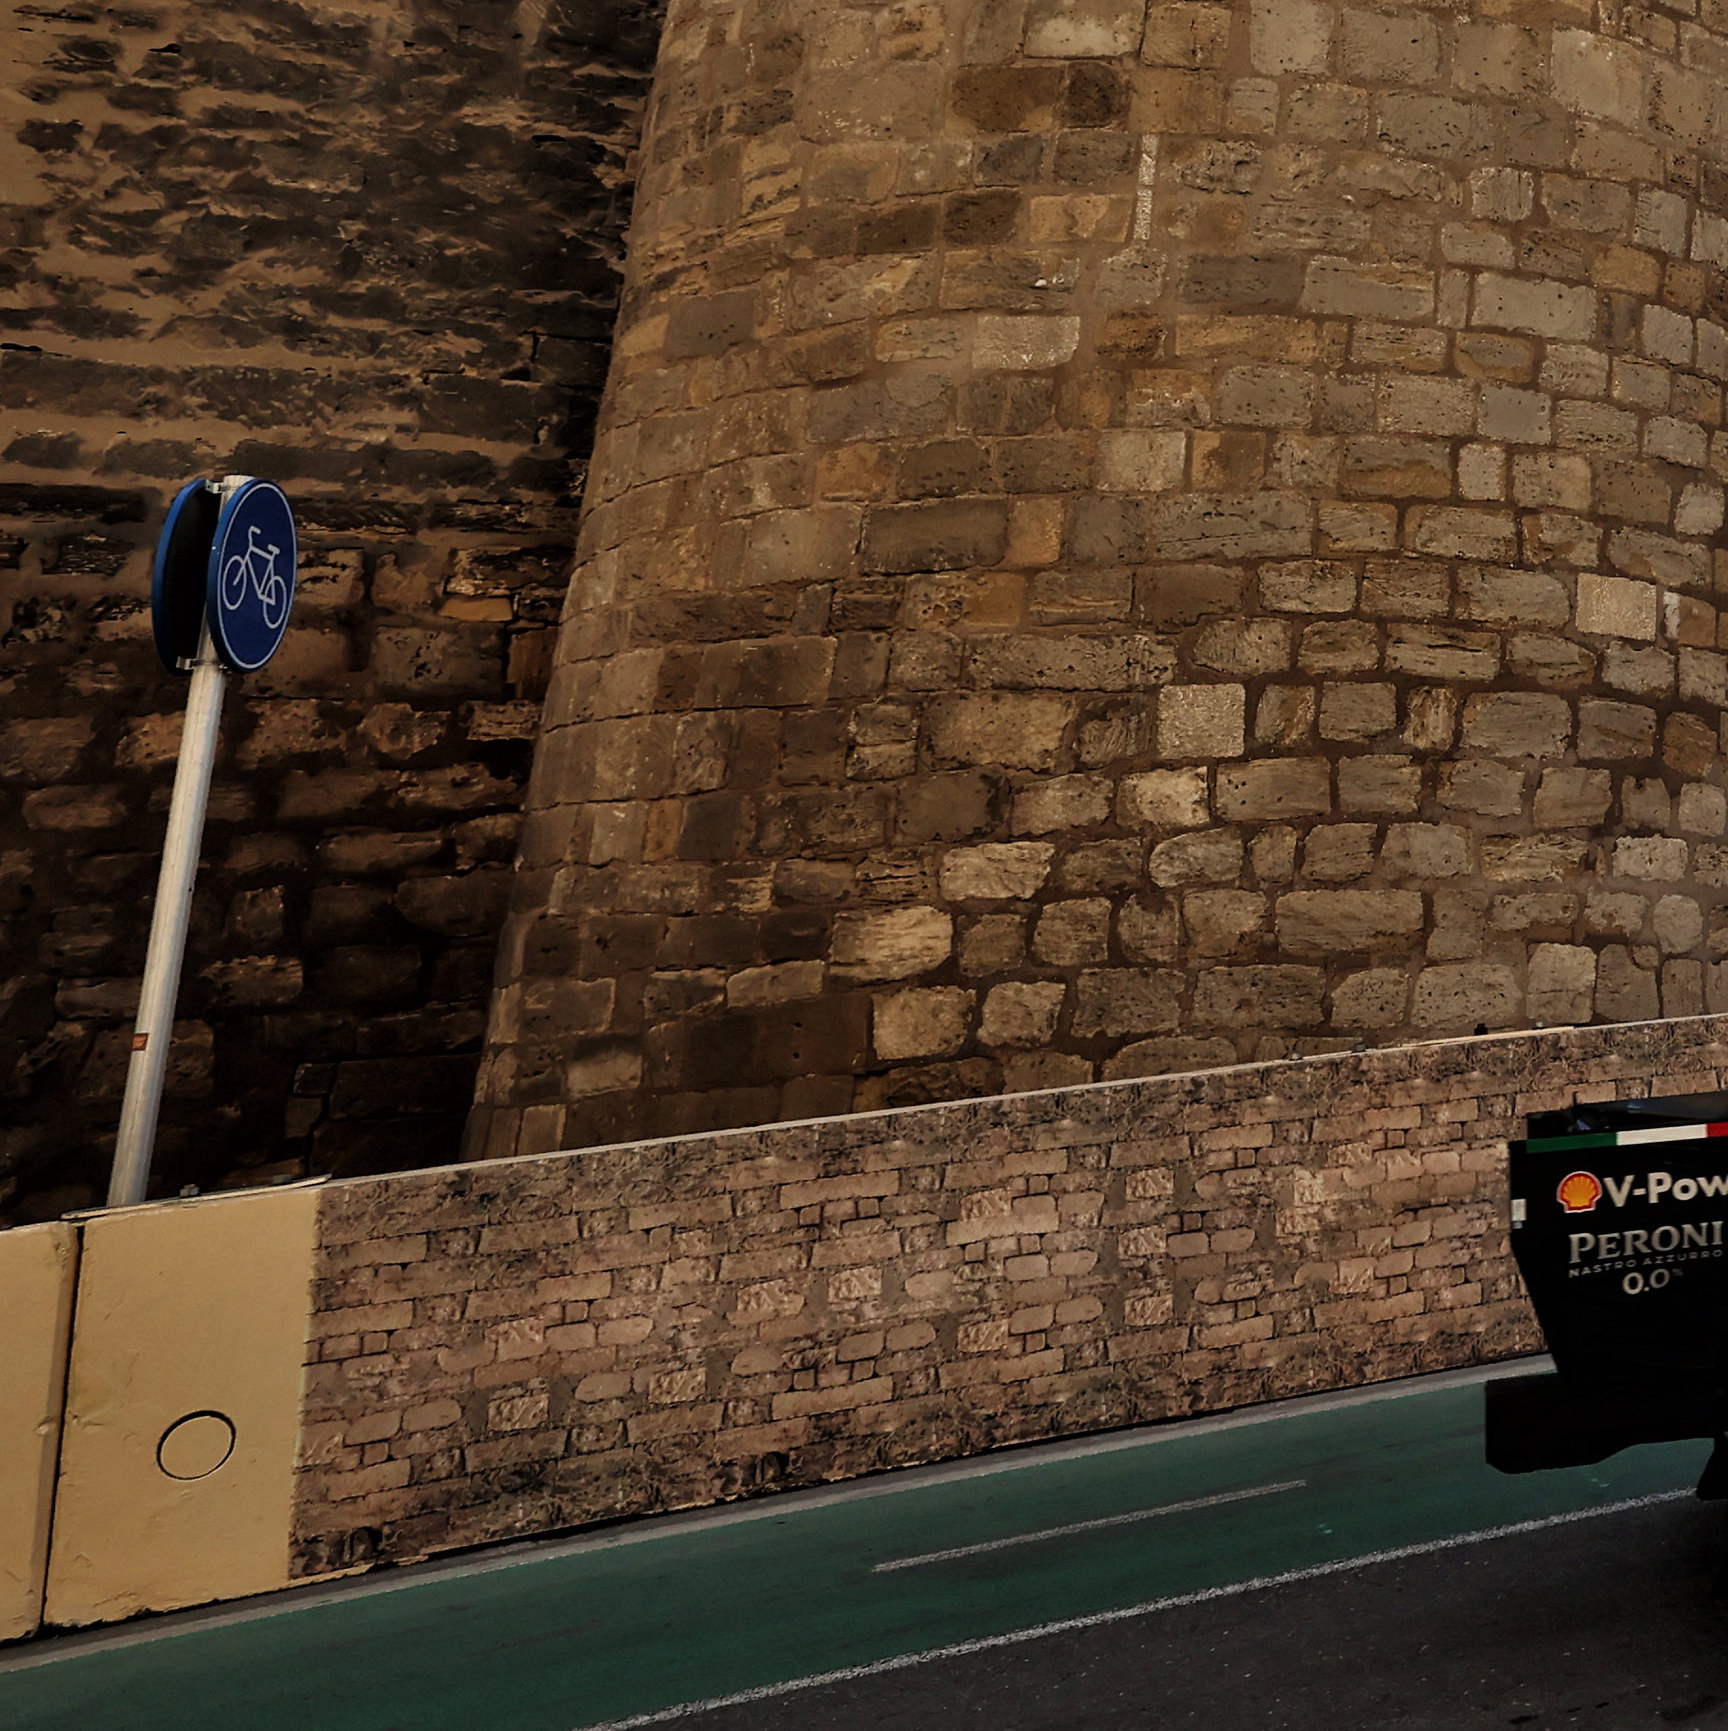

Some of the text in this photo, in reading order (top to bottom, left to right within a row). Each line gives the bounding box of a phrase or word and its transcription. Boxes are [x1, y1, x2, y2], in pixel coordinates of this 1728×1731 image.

[1568, 1220, 1724, 1264] PERONI
[1568, 1249, 1724, 1278] NASTRO AZZURRO
